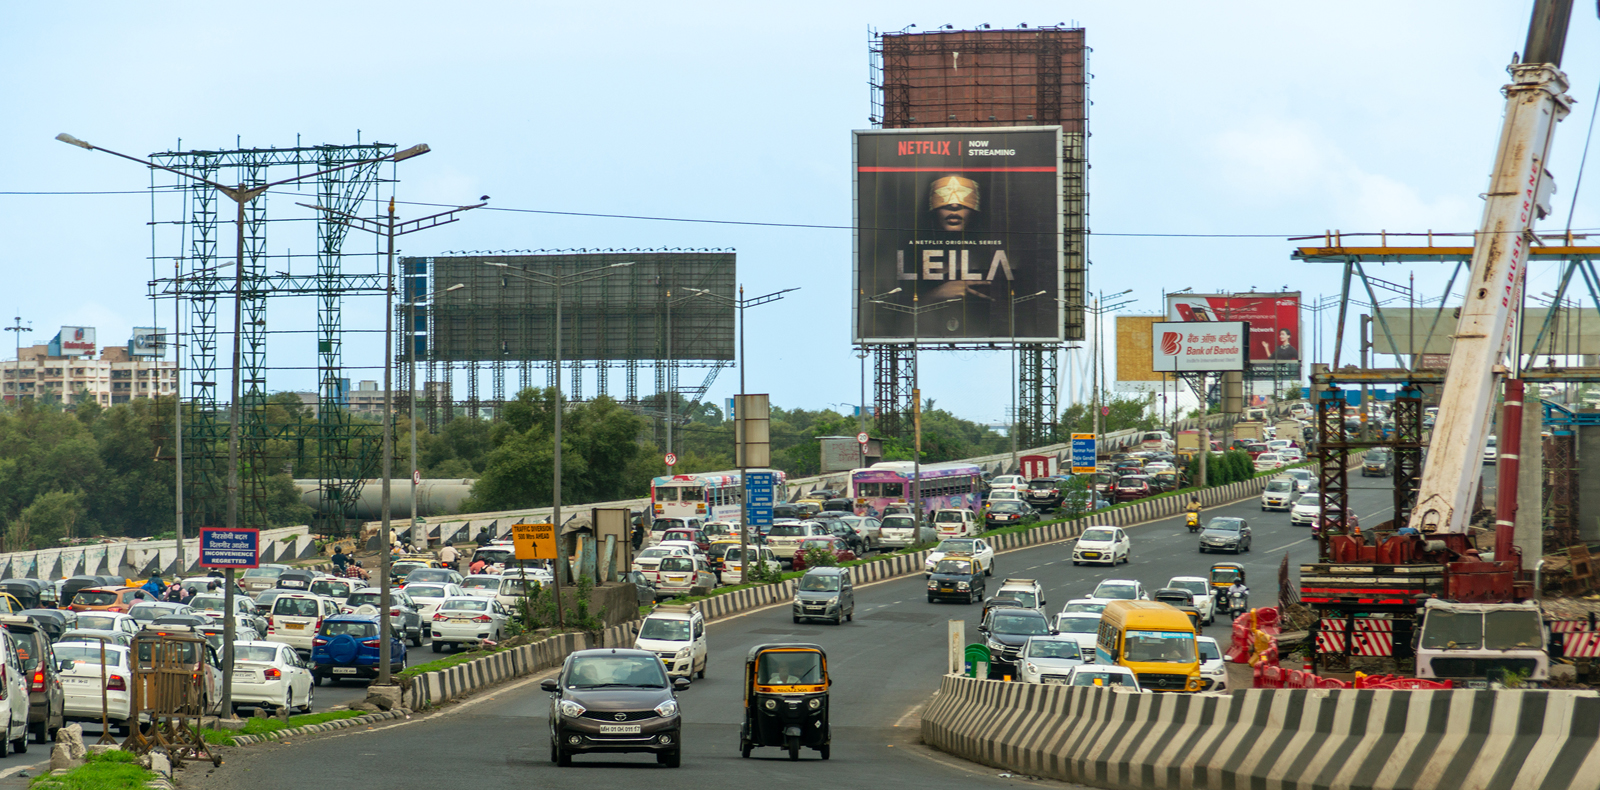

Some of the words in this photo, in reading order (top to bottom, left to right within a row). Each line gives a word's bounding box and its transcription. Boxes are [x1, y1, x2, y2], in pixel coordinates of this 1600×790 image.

[898, 141, 950, 156] NETFLIX
[1502, 234, 1522, 308] BABUSH
[1520, 161, 1539, 223] CRANE
[896, 250, 1014, 280] LEILA
[1186, 346, 1205, 355] Bank
[1206, 346, 1213, 355] of
[1214, 346, 1239, 355] Baroda
